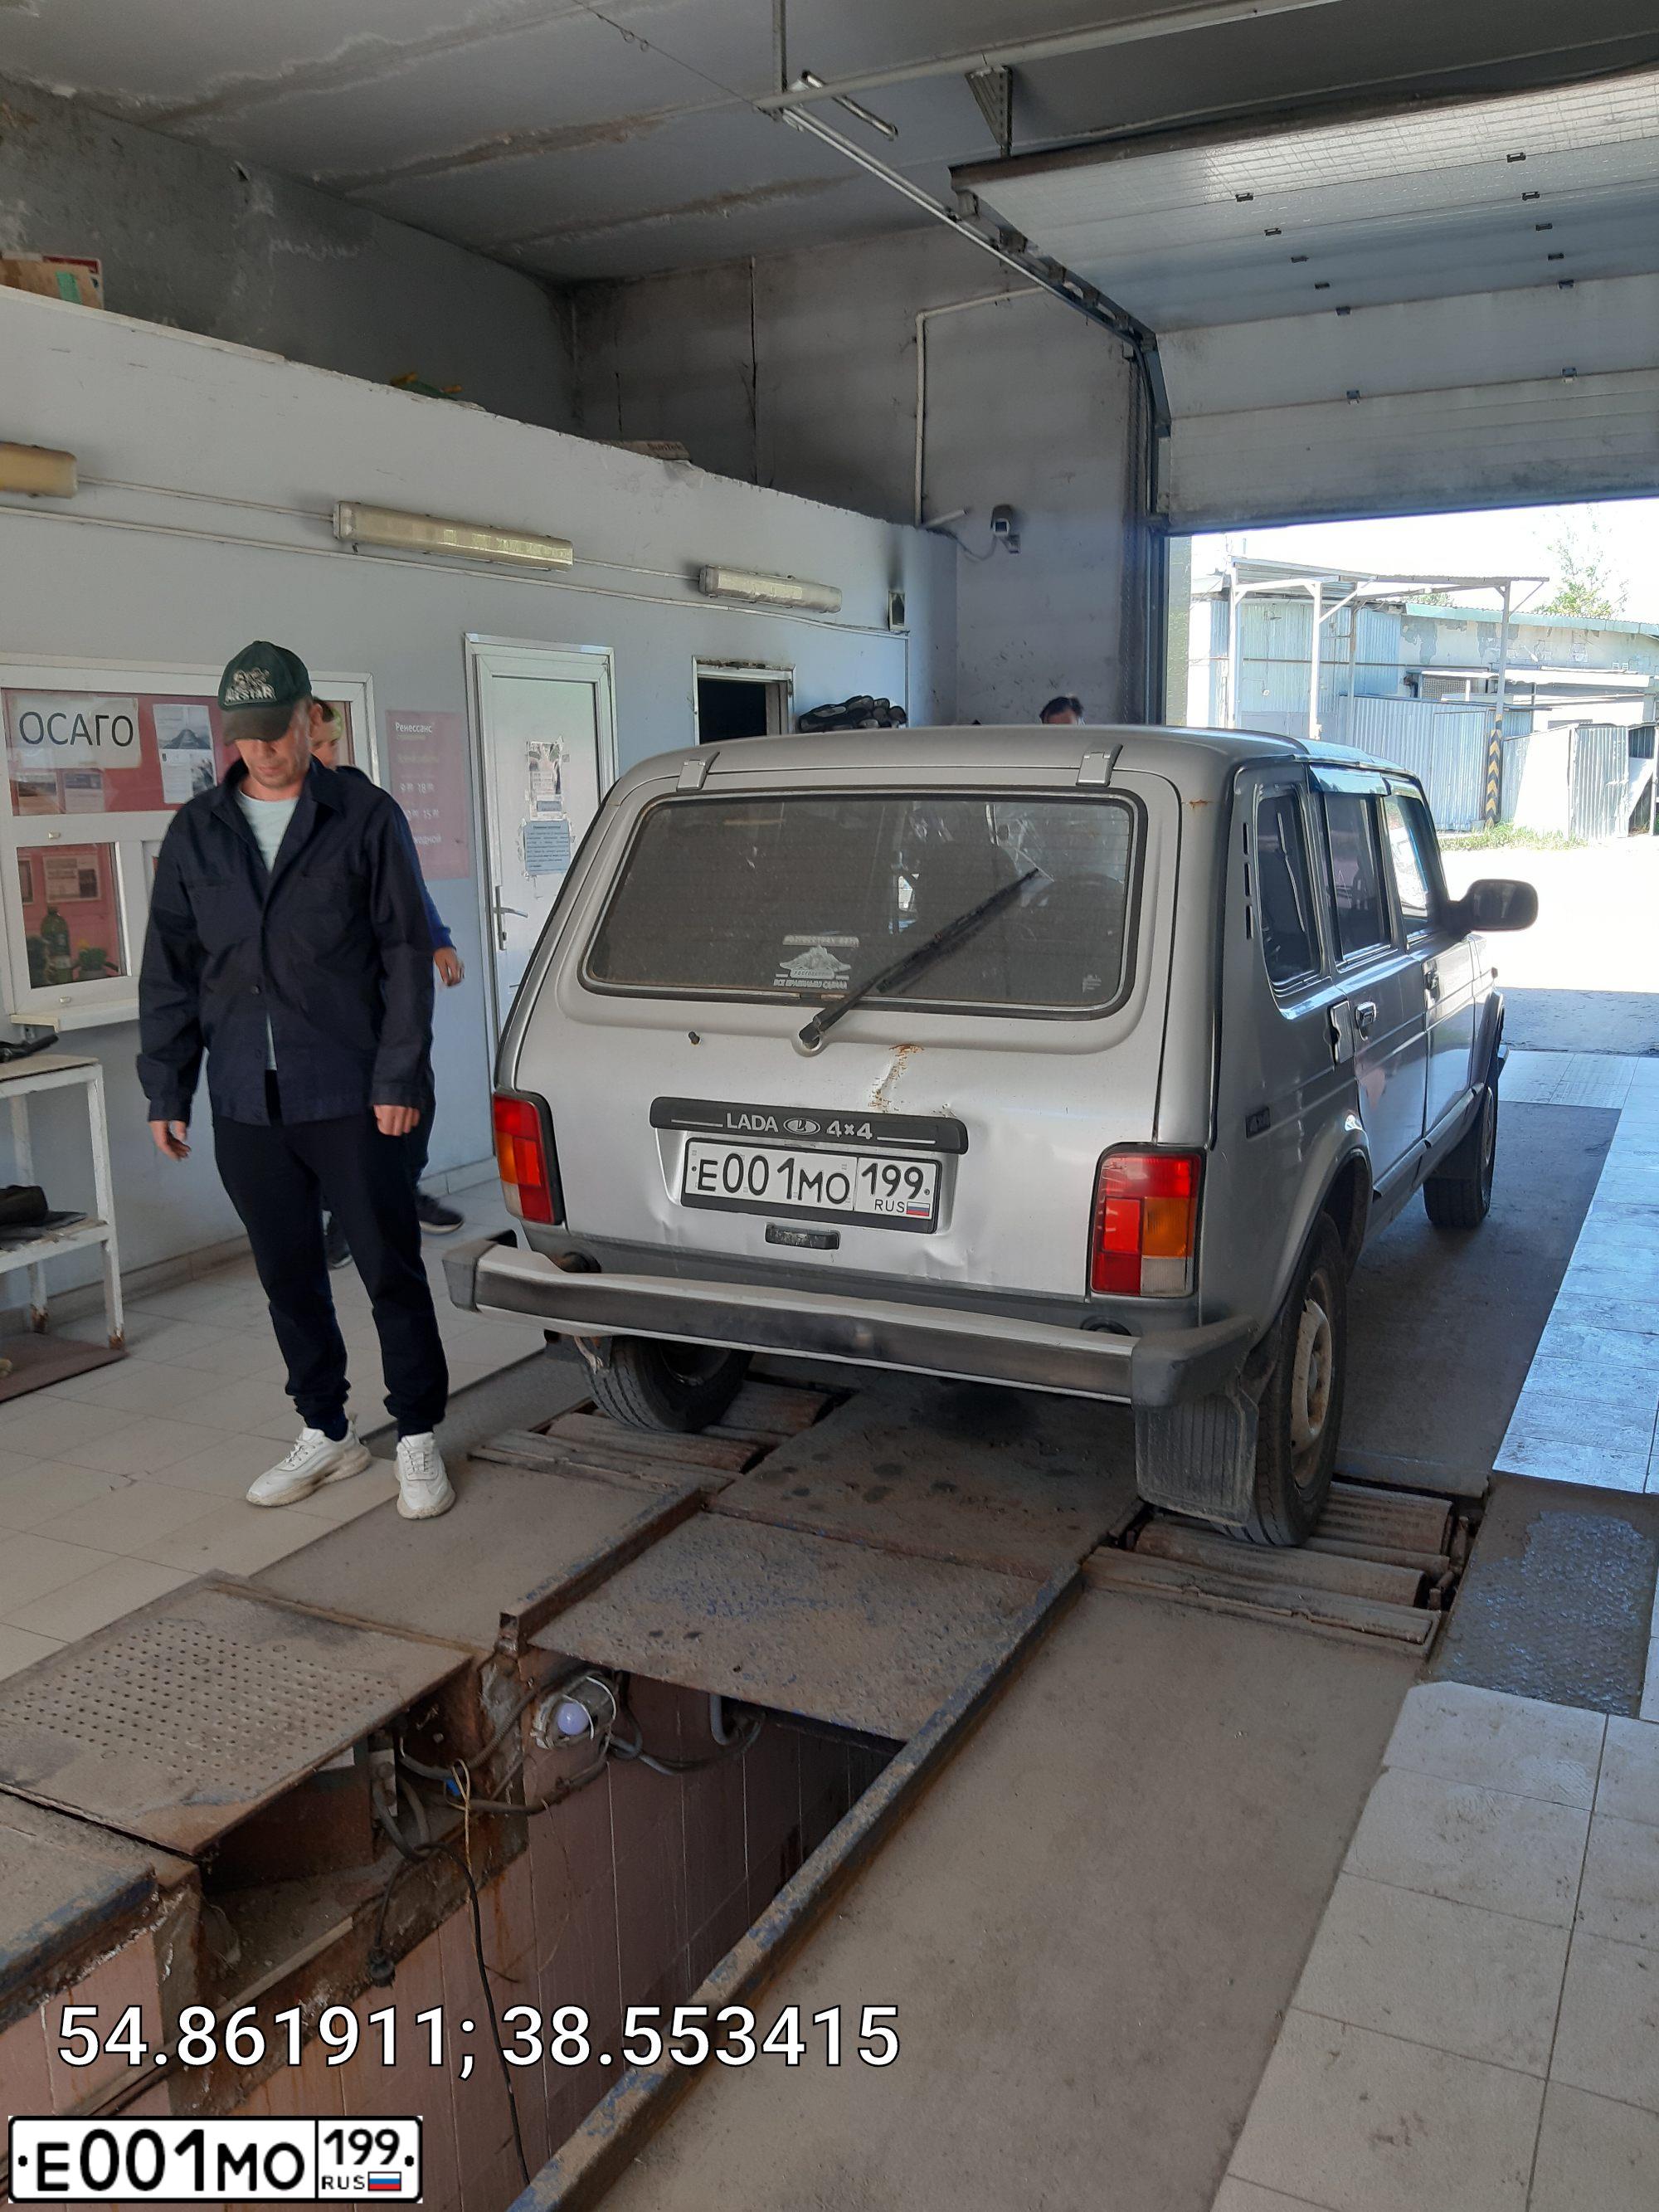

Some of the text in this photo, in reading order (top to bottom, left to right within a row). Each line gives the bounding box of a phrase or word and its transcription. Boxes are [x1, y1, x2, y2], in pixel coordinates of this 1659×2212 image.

[18, 711, 134, 748] ОСАГО
[726, 1113, 779, 1133] LADA
[861, 1162, 925, 1200] 199
[874, 1198, 905, 1214] RUS
